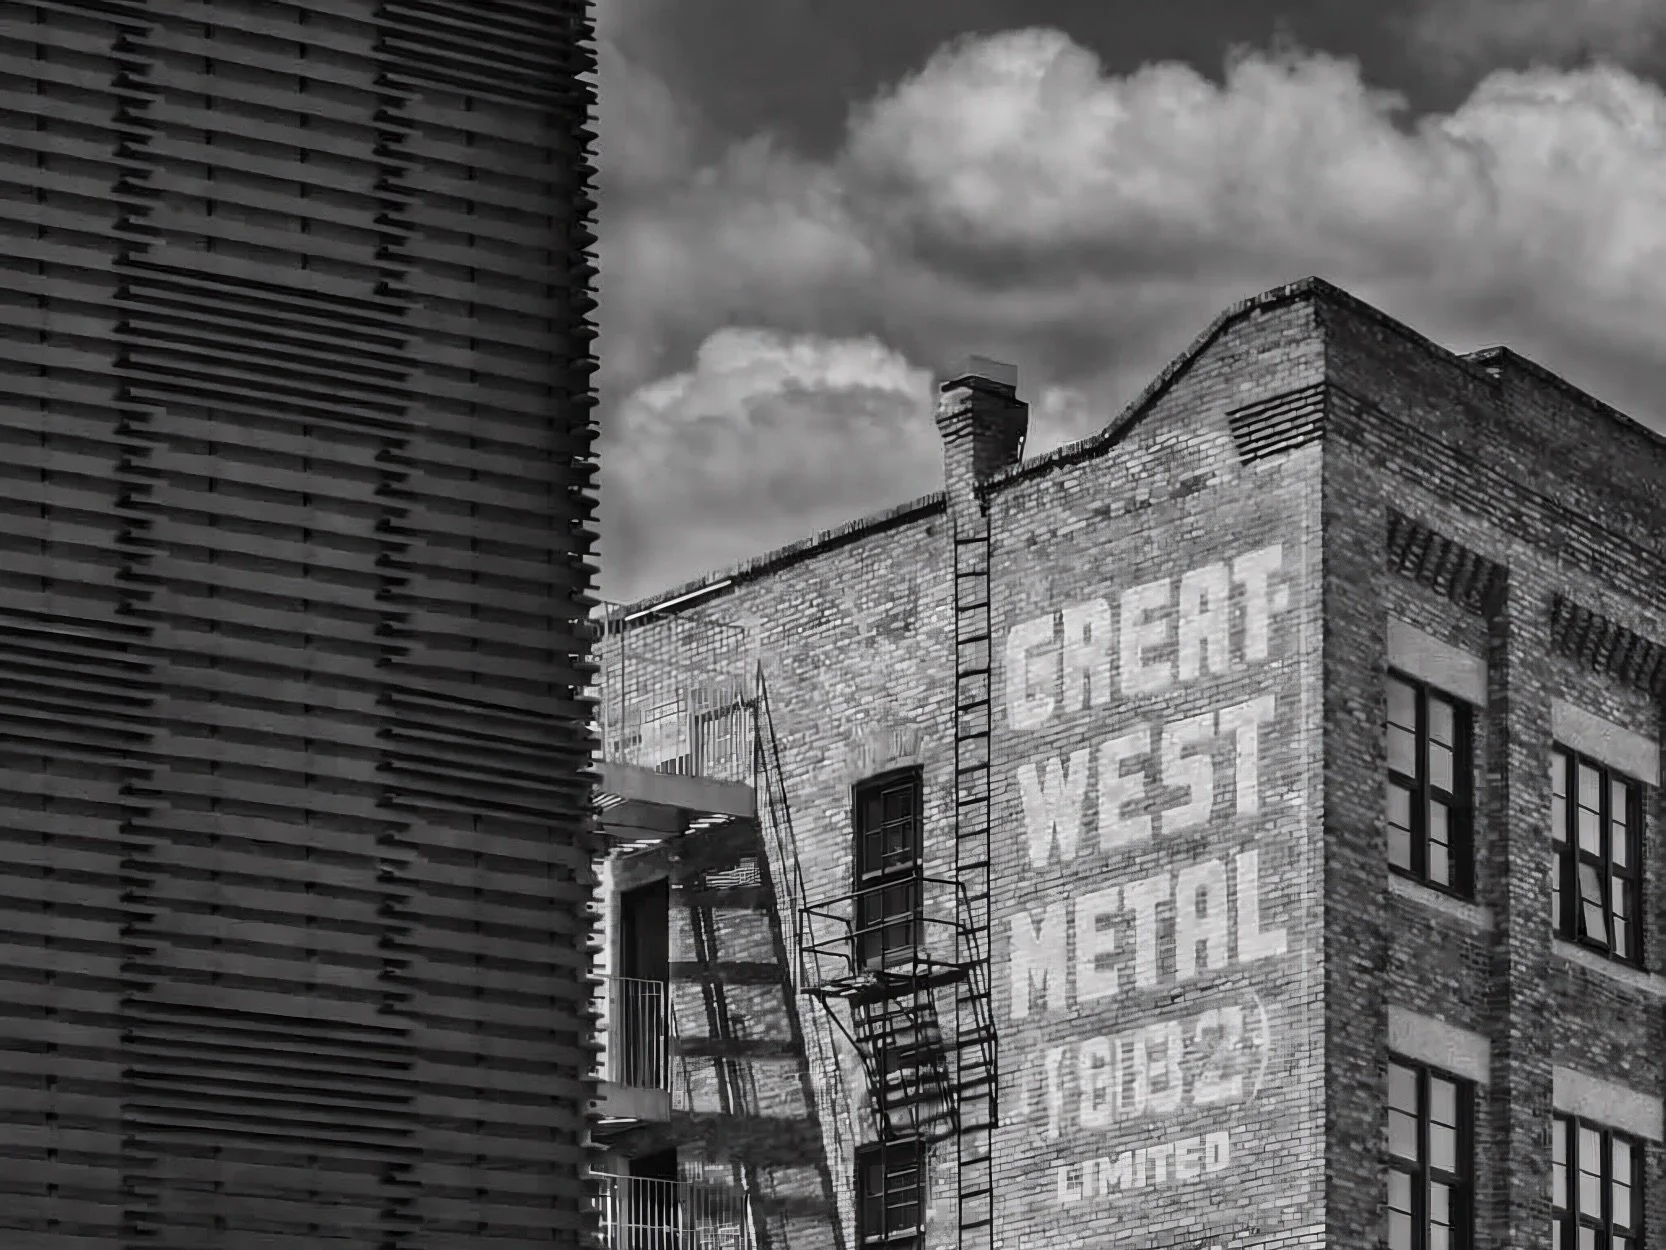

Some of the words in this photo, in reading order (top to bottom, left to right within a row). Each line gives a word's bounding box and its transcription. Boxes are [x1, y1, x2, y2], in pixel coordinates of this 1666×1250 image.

[1006, 543, 1285, 731] GREAT
[1018, 694, 1275, 868] WEST
[1009, 850, 1287, 1019] METAL
[1058, 1131, 1230, 1201] LIMITED
